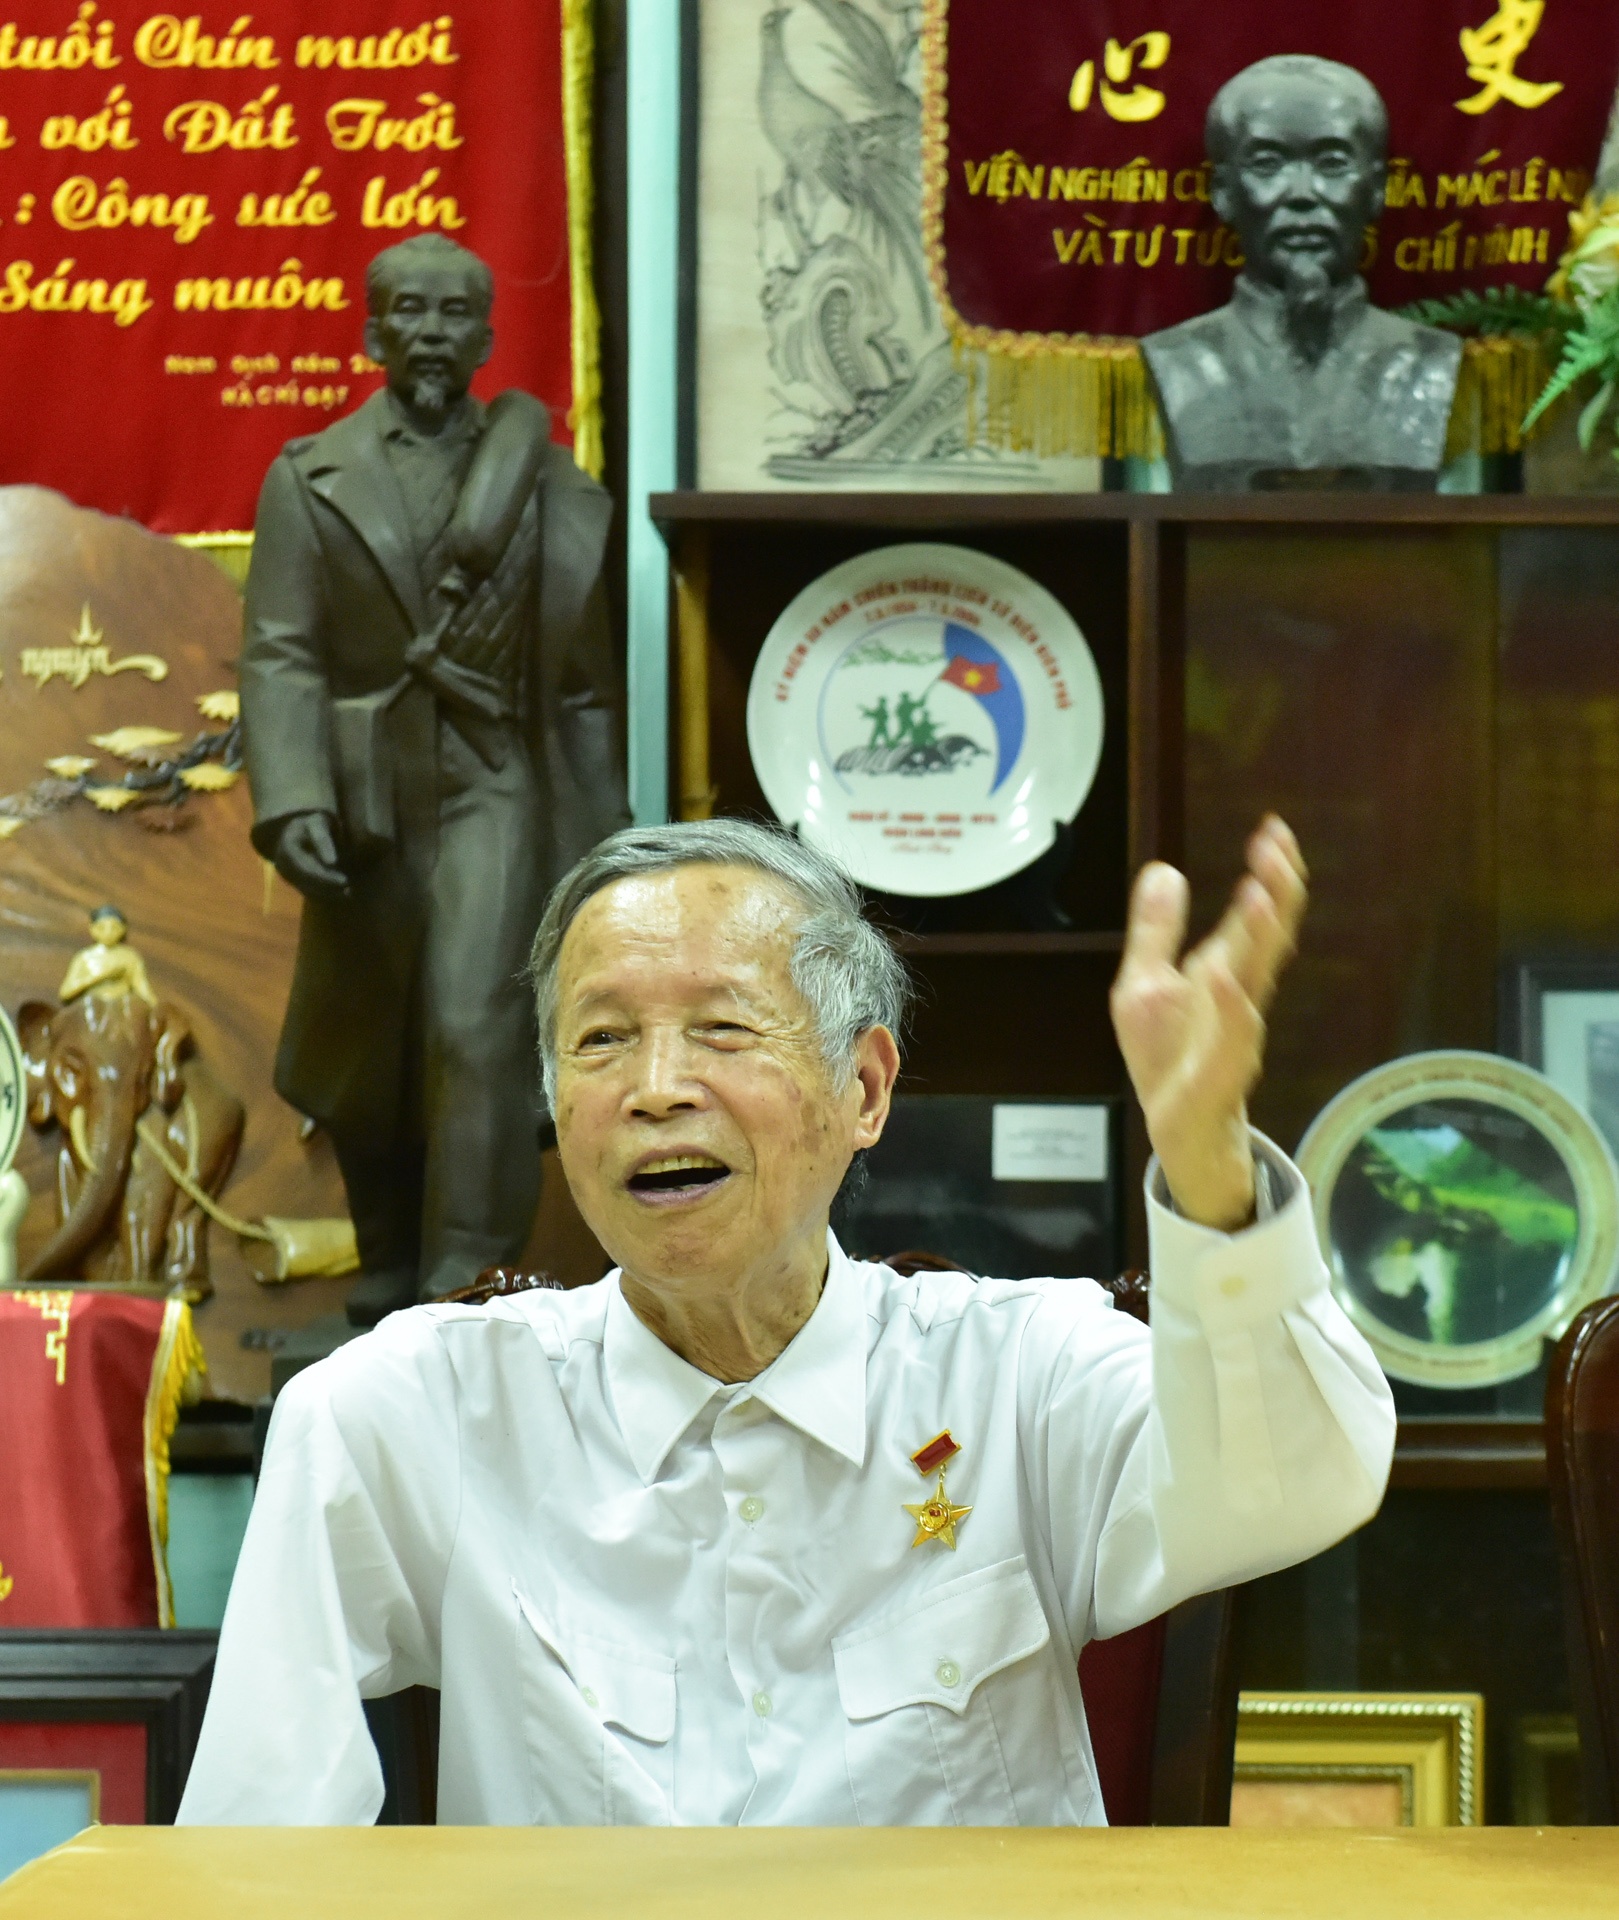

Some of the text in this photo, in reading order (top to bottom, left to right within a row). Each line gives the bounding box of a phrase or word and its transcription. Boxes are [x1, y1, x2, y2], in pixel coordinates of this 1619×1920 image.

[0, 0, 460, 70] tuổi Chín mươi
[1068, 30, 1171, 122] 心
[40, 83, 140, 152] với
[163, 84, 300, 153] Đất
[326, 91, 464, 152] Trời
[52, 175, 215, 245] Công
[236, 166, 338, 228] sức
[361, 166, 468, 230] lớn
[963, 149, 1046, 204] VIỆN
[1047, 156, 1168, 204] NGHIÊN
[1052, 212, 1107, 266] VÀ
[0, 257, 351, 328] Sáng muôn
